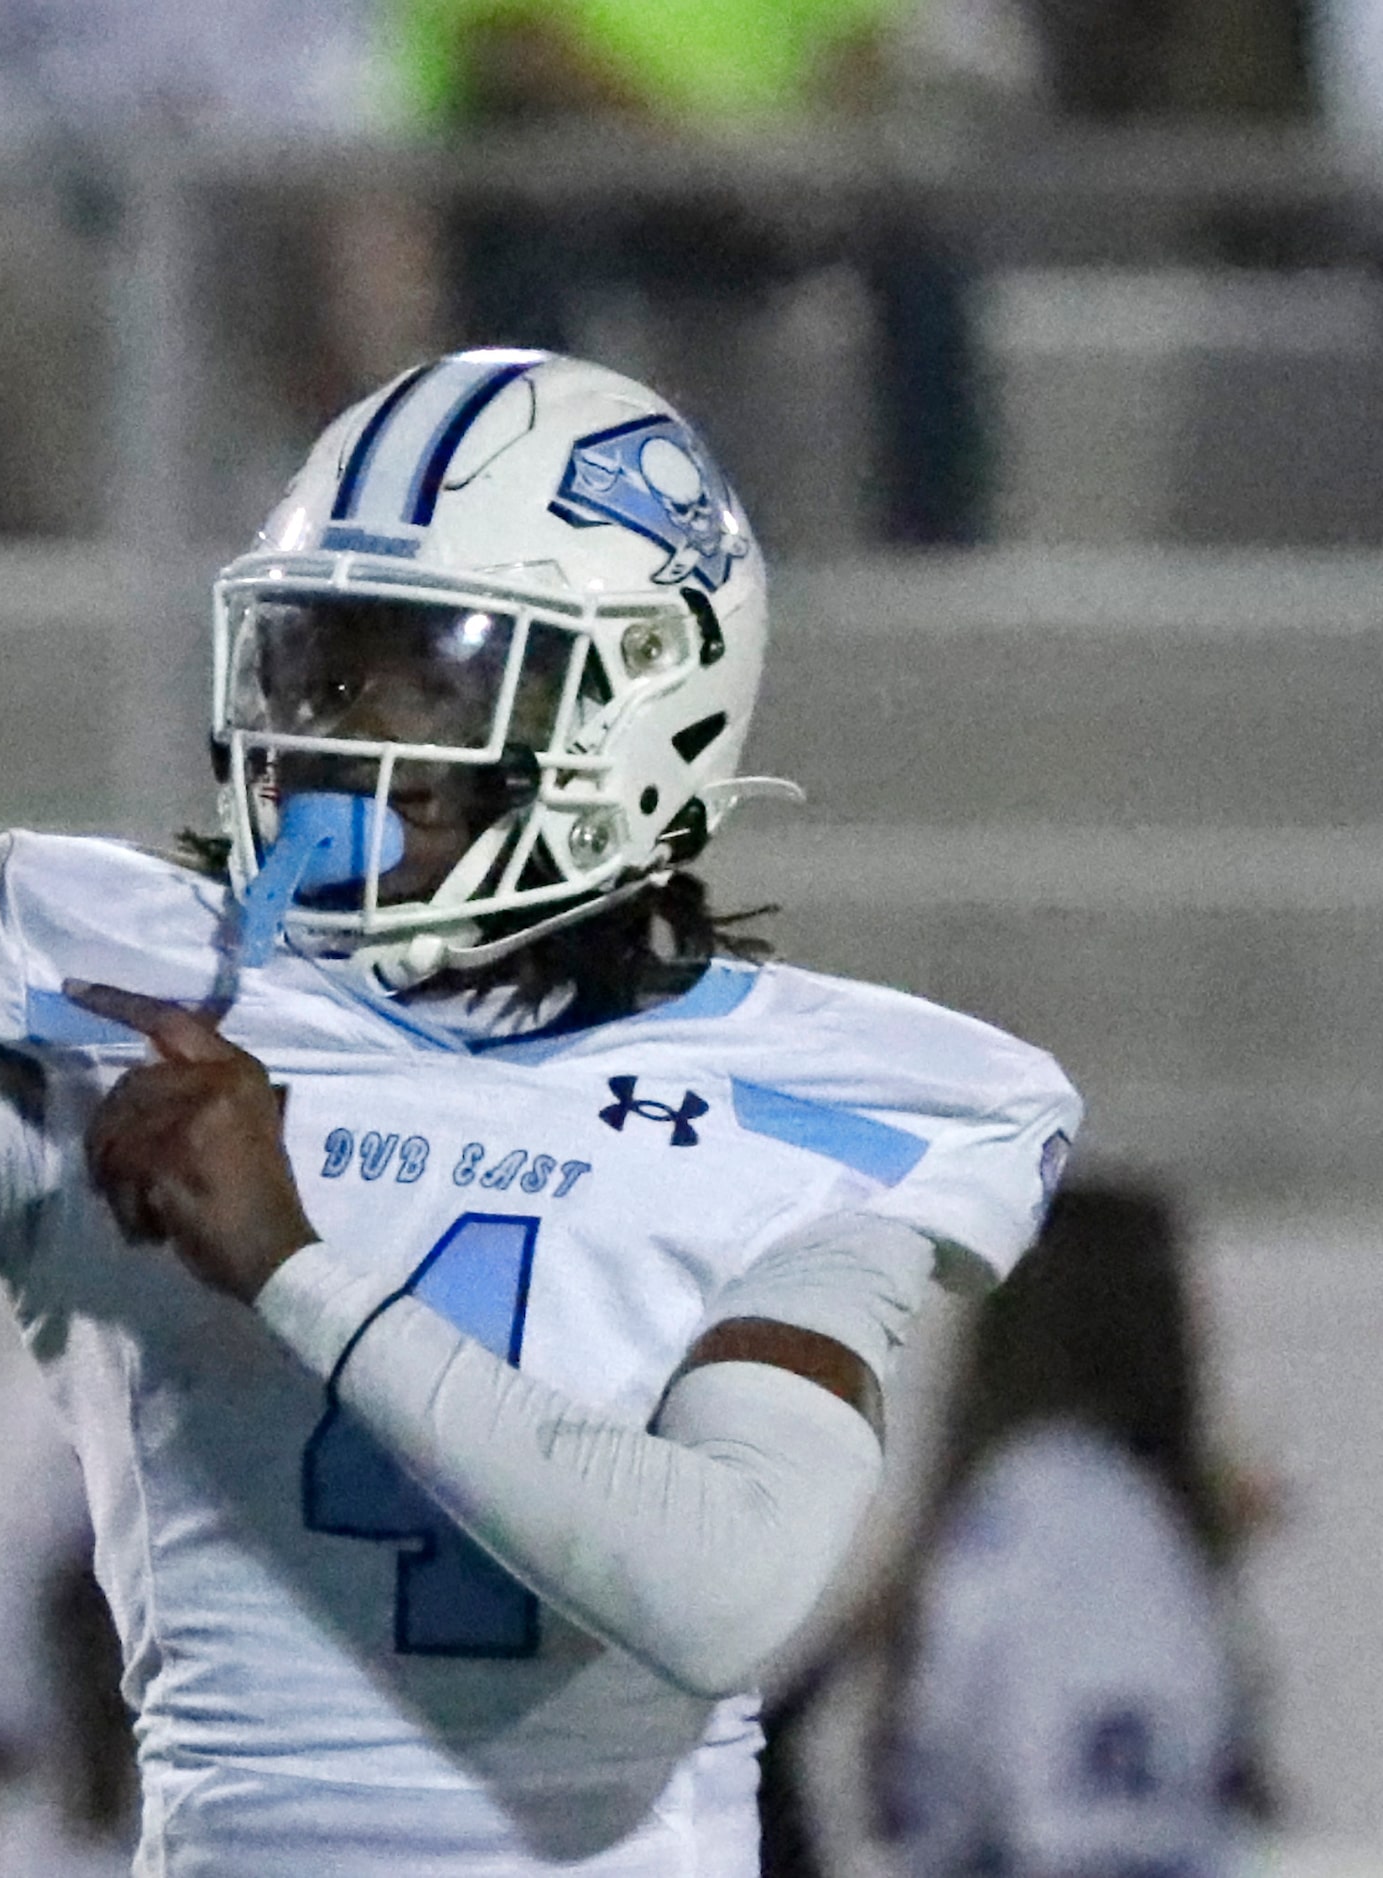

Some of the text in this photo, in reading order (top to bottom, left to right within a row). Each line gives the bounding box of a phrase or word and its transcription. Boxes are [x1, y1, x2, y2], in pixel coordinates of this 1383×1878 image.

[320, 1127, 592, 1198] DUB EAST
[302, 1212, 542, 1660] 4
